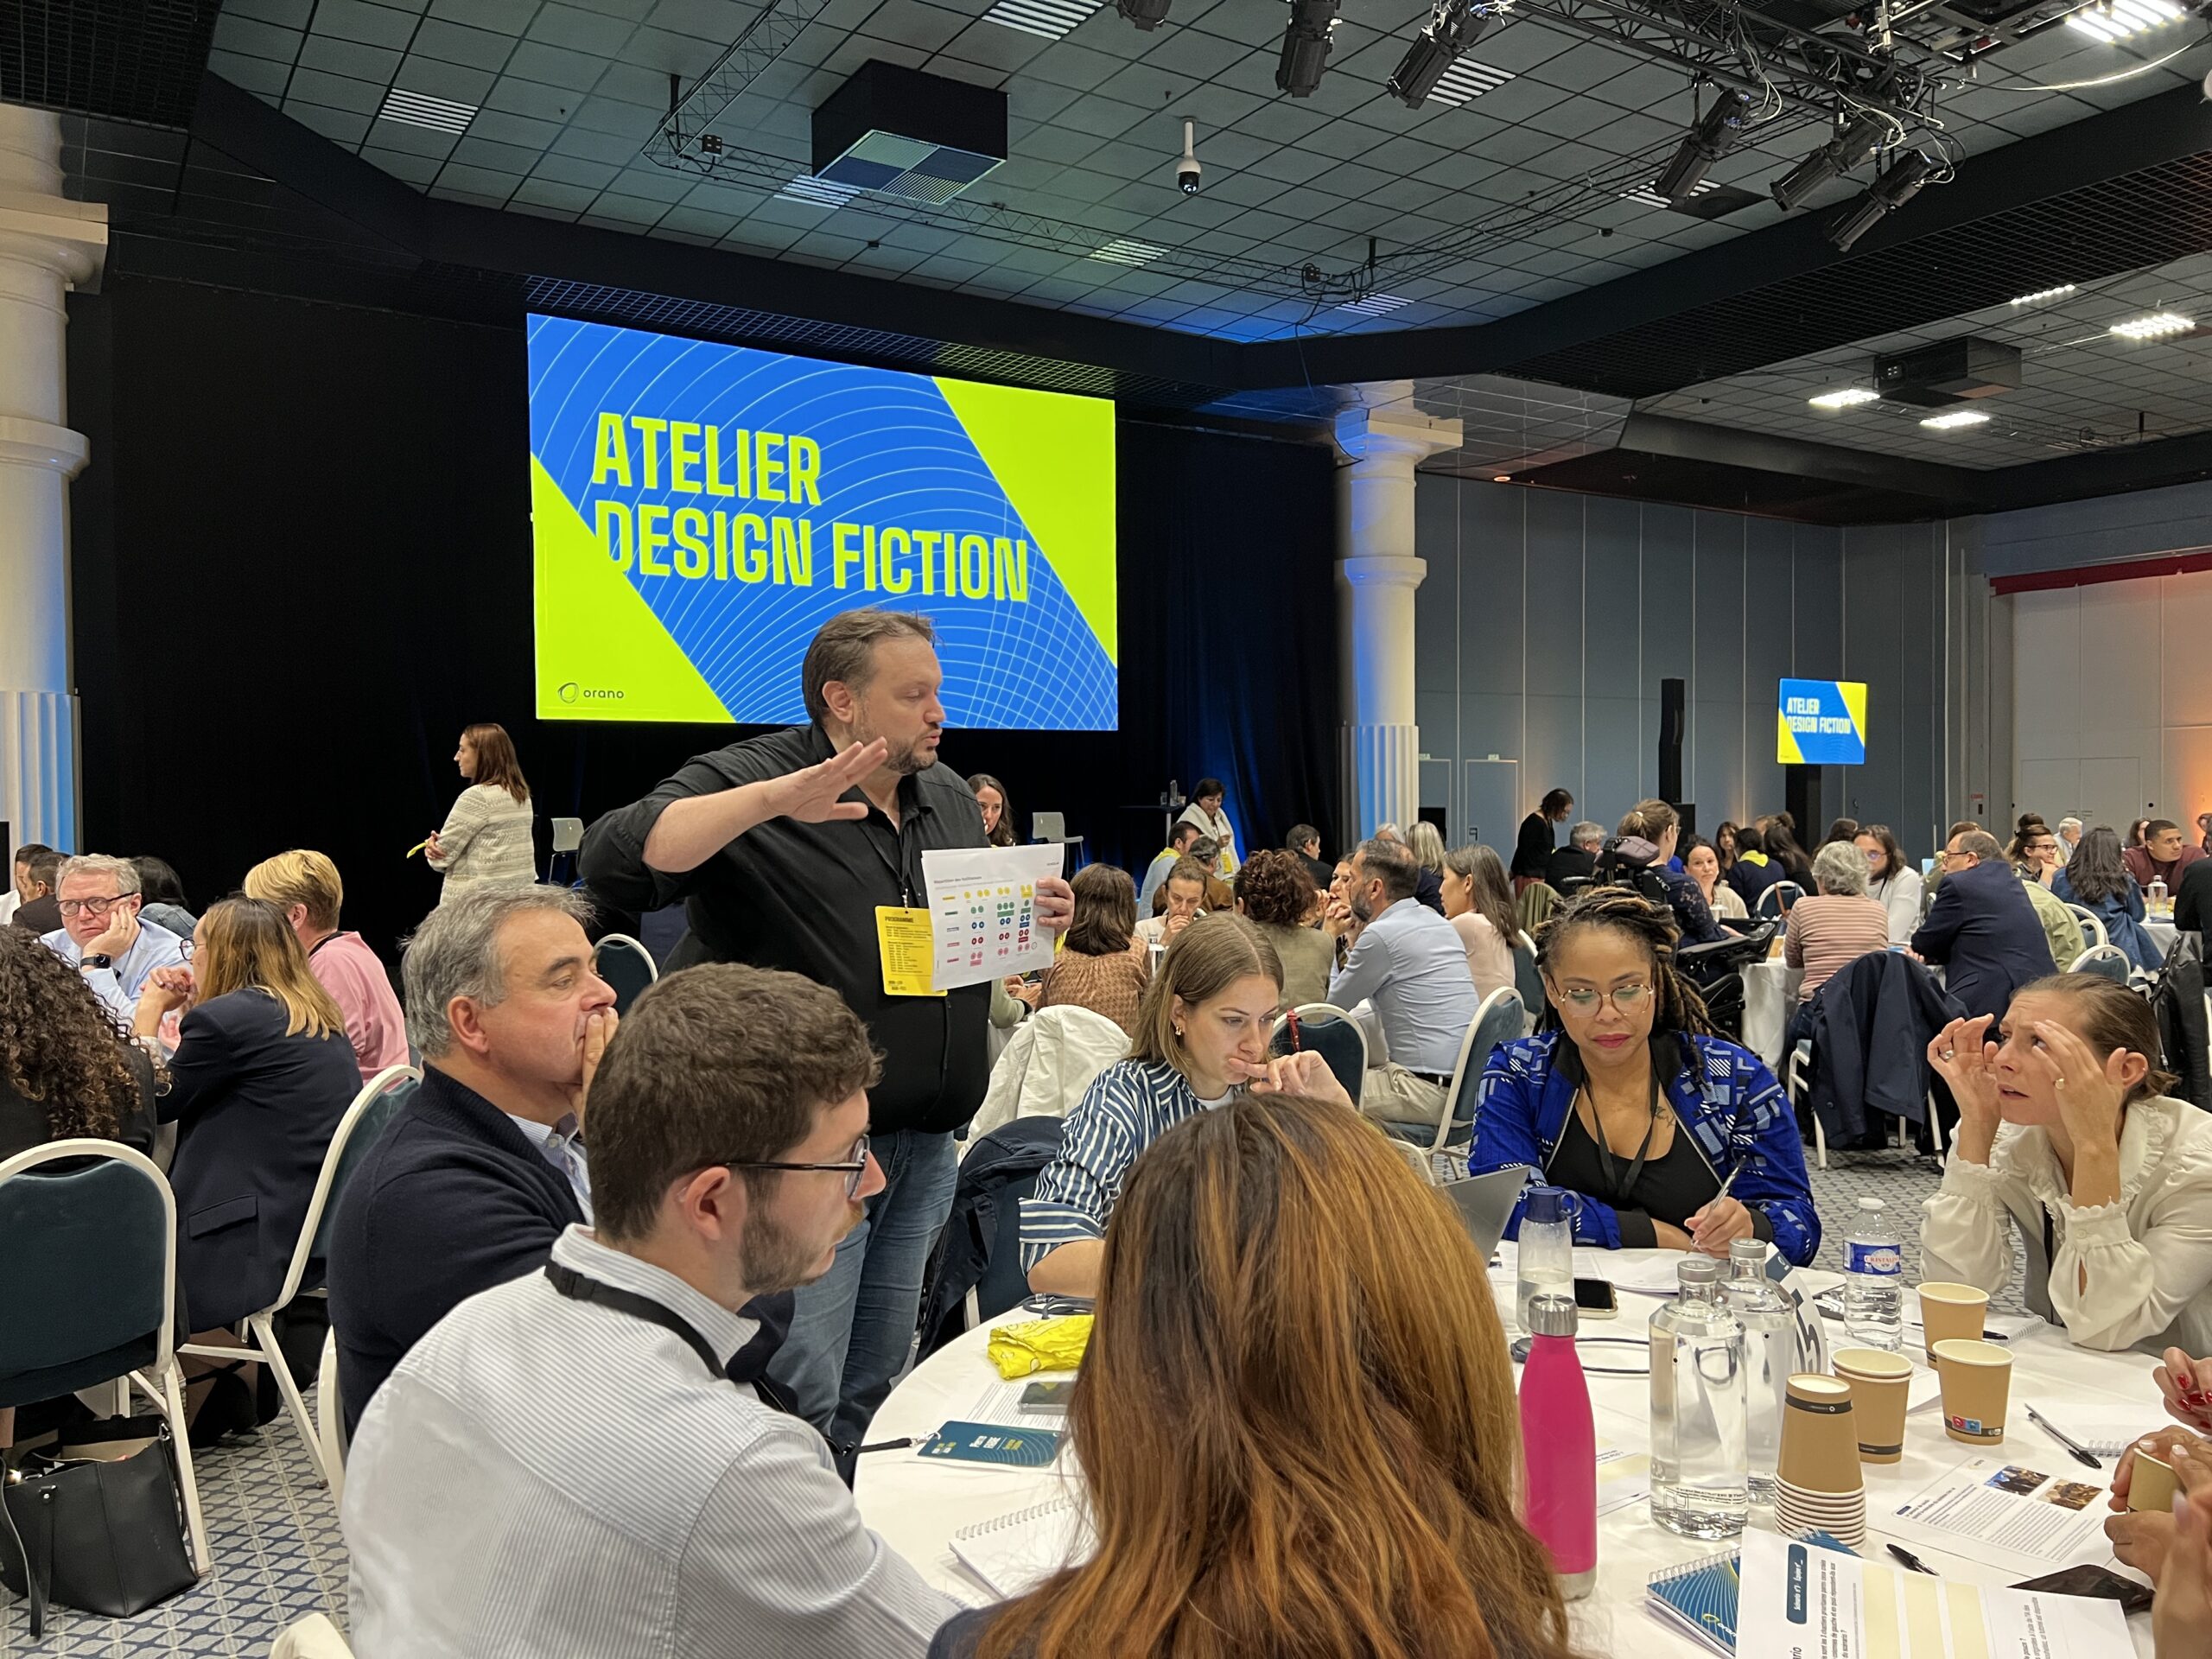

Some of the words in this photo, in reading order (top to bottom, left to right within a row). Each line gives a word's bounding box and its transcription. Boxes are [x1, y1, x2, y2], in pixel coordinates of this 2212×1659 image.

[592, 411, 822, 505] ATELIER
[594, 499, 812, 587] DESIGN
[833, 522, 1027, 602] FICTION
[583, 690, 625, 699] orano
[1786, 697, 1820, 715] ATELIER
[1786, 715, 1818, 733] DESIGN
[1819, 717, 1852, 734] FICTION
